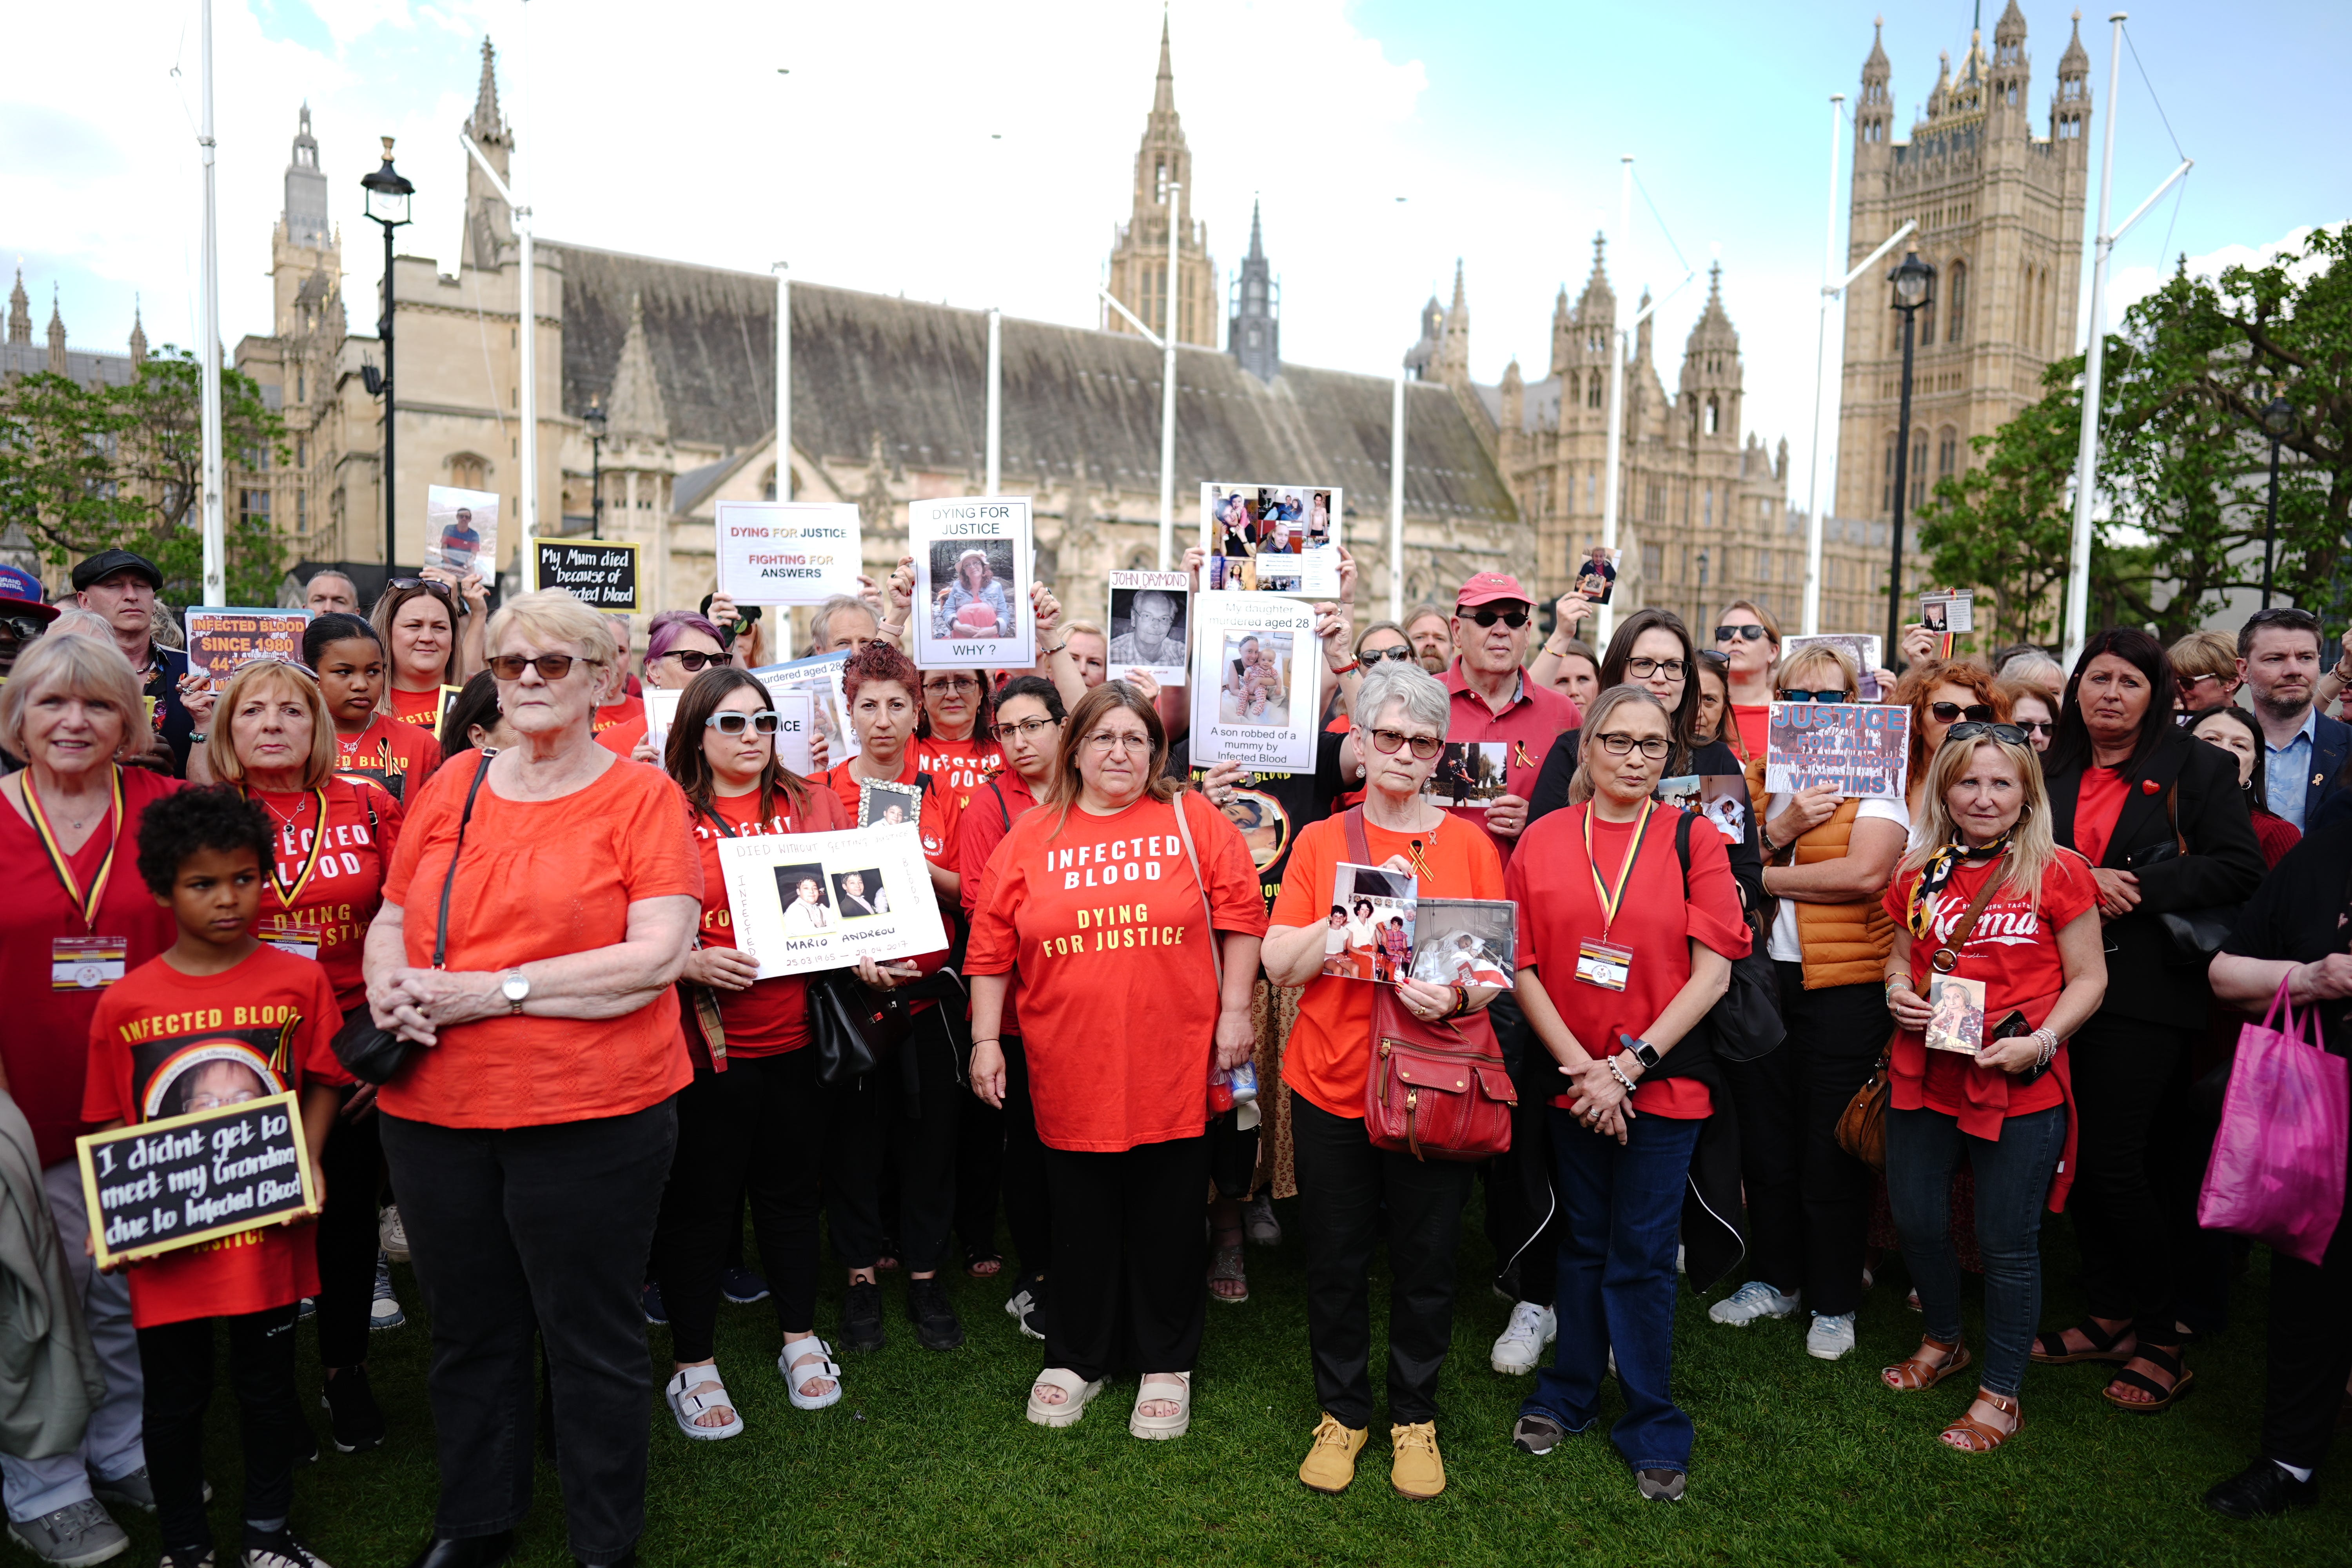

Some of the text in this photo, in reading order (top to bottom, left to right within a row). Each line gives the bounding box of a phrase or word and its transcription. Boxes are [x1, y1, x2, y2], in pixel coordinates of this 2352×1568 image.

[933, 507, 1009, 519] DYING FOR
[731, 527, 847, 538] DYING FOR JUSTICE
[942, 523, 1000, 534] JUSTICE
[542, 548, 629, 571] My Mum died
[749, 555, 833, 565] FIGHTING FOR
[557, 567, 622, 584] because of
[761, 568, 821, 578] ANSWERS
[1112, 572, 1187, 586] JOHN DAYMOND
[603, 586, 634, 602] blood
[1226, 603, 1293, 615] My daughter
[192, 619, 306, 633] INFECTED BLOOD
[1209, 617, 1309, 629] murdered aged 28
[201, 637, 294, 653] SINCE 1980
[953, 644, 996, 655] WHY ?
[210, 657, 230, 672] 44
[804, 665, 827, 677] aged
[829, 662, 842, 672] 28
[1772, 705, 1907, 732] JUSTICE
[1211, 727, 1218, 735] A
[1241, 730, 1274, 739] robbed
[1225, 742, 1278, 752] mummy by
[1797, 733, 1878, 752] FOR ALL
[1218, 751, 1287, 763] Infected Blood
[1769, 752, 1904, 769] INFECTED BLOOD
[1788, 773, 1886, 793] VICTIMS
[737, 831, 909, 857] DIED WITHOUT GETTING JUSTICE
[1048, 835, 1180, 872] INFECTED
[902, 858, 920, 904] BLOOD
[1064, 862, 1160, 889] BLOOD
[274, 904, 350, 932] DYING
[738, 875, 756, 956] INFECTED
[1077, 904, 1147, 929] DYING
[786, 927, 895, 951] MARIO ANDREOU
[1043, 927, 1185, 958] FOR JUSTICE
[786, 953, 836, 966] 25.03.1965
[119, 1008, 222, 1042] INFECTED
[96, 1115, 288, 1178] I didnt get to
[101, 1145, 296, 1210] meet my Grandma
[105, 1172, 301, 1246] due to Infected Blood
